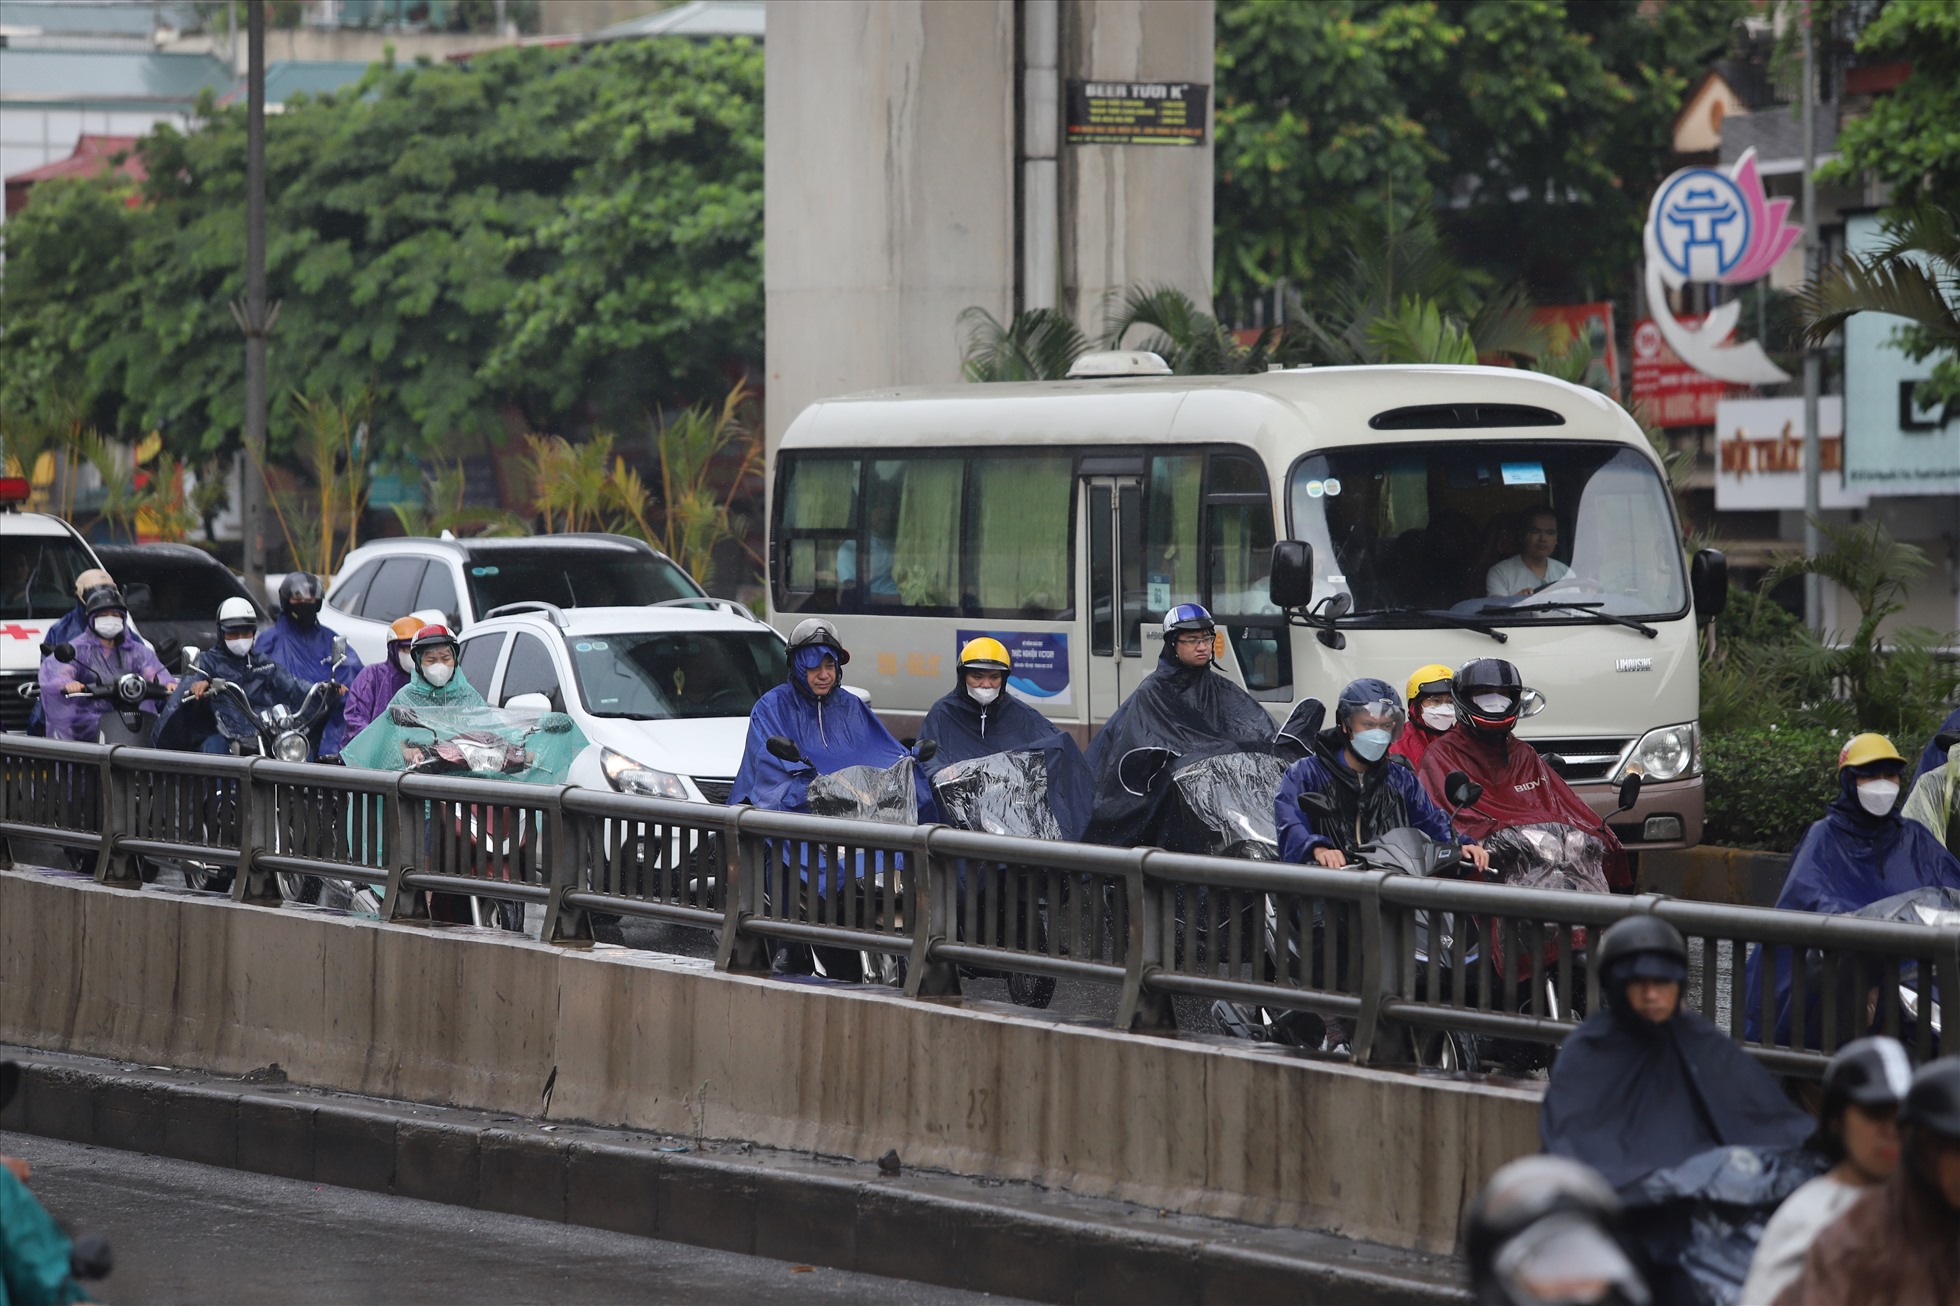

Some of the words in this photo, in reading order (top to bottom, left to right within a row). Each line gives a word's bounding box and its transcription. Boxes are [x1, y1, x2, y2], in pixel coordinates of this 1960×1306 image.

[1085, 84, 1127, 97] BEER
[1616, 658, 1652, 672] LIMOUSINE
[1514, 777, 1541, 793] BIDV
